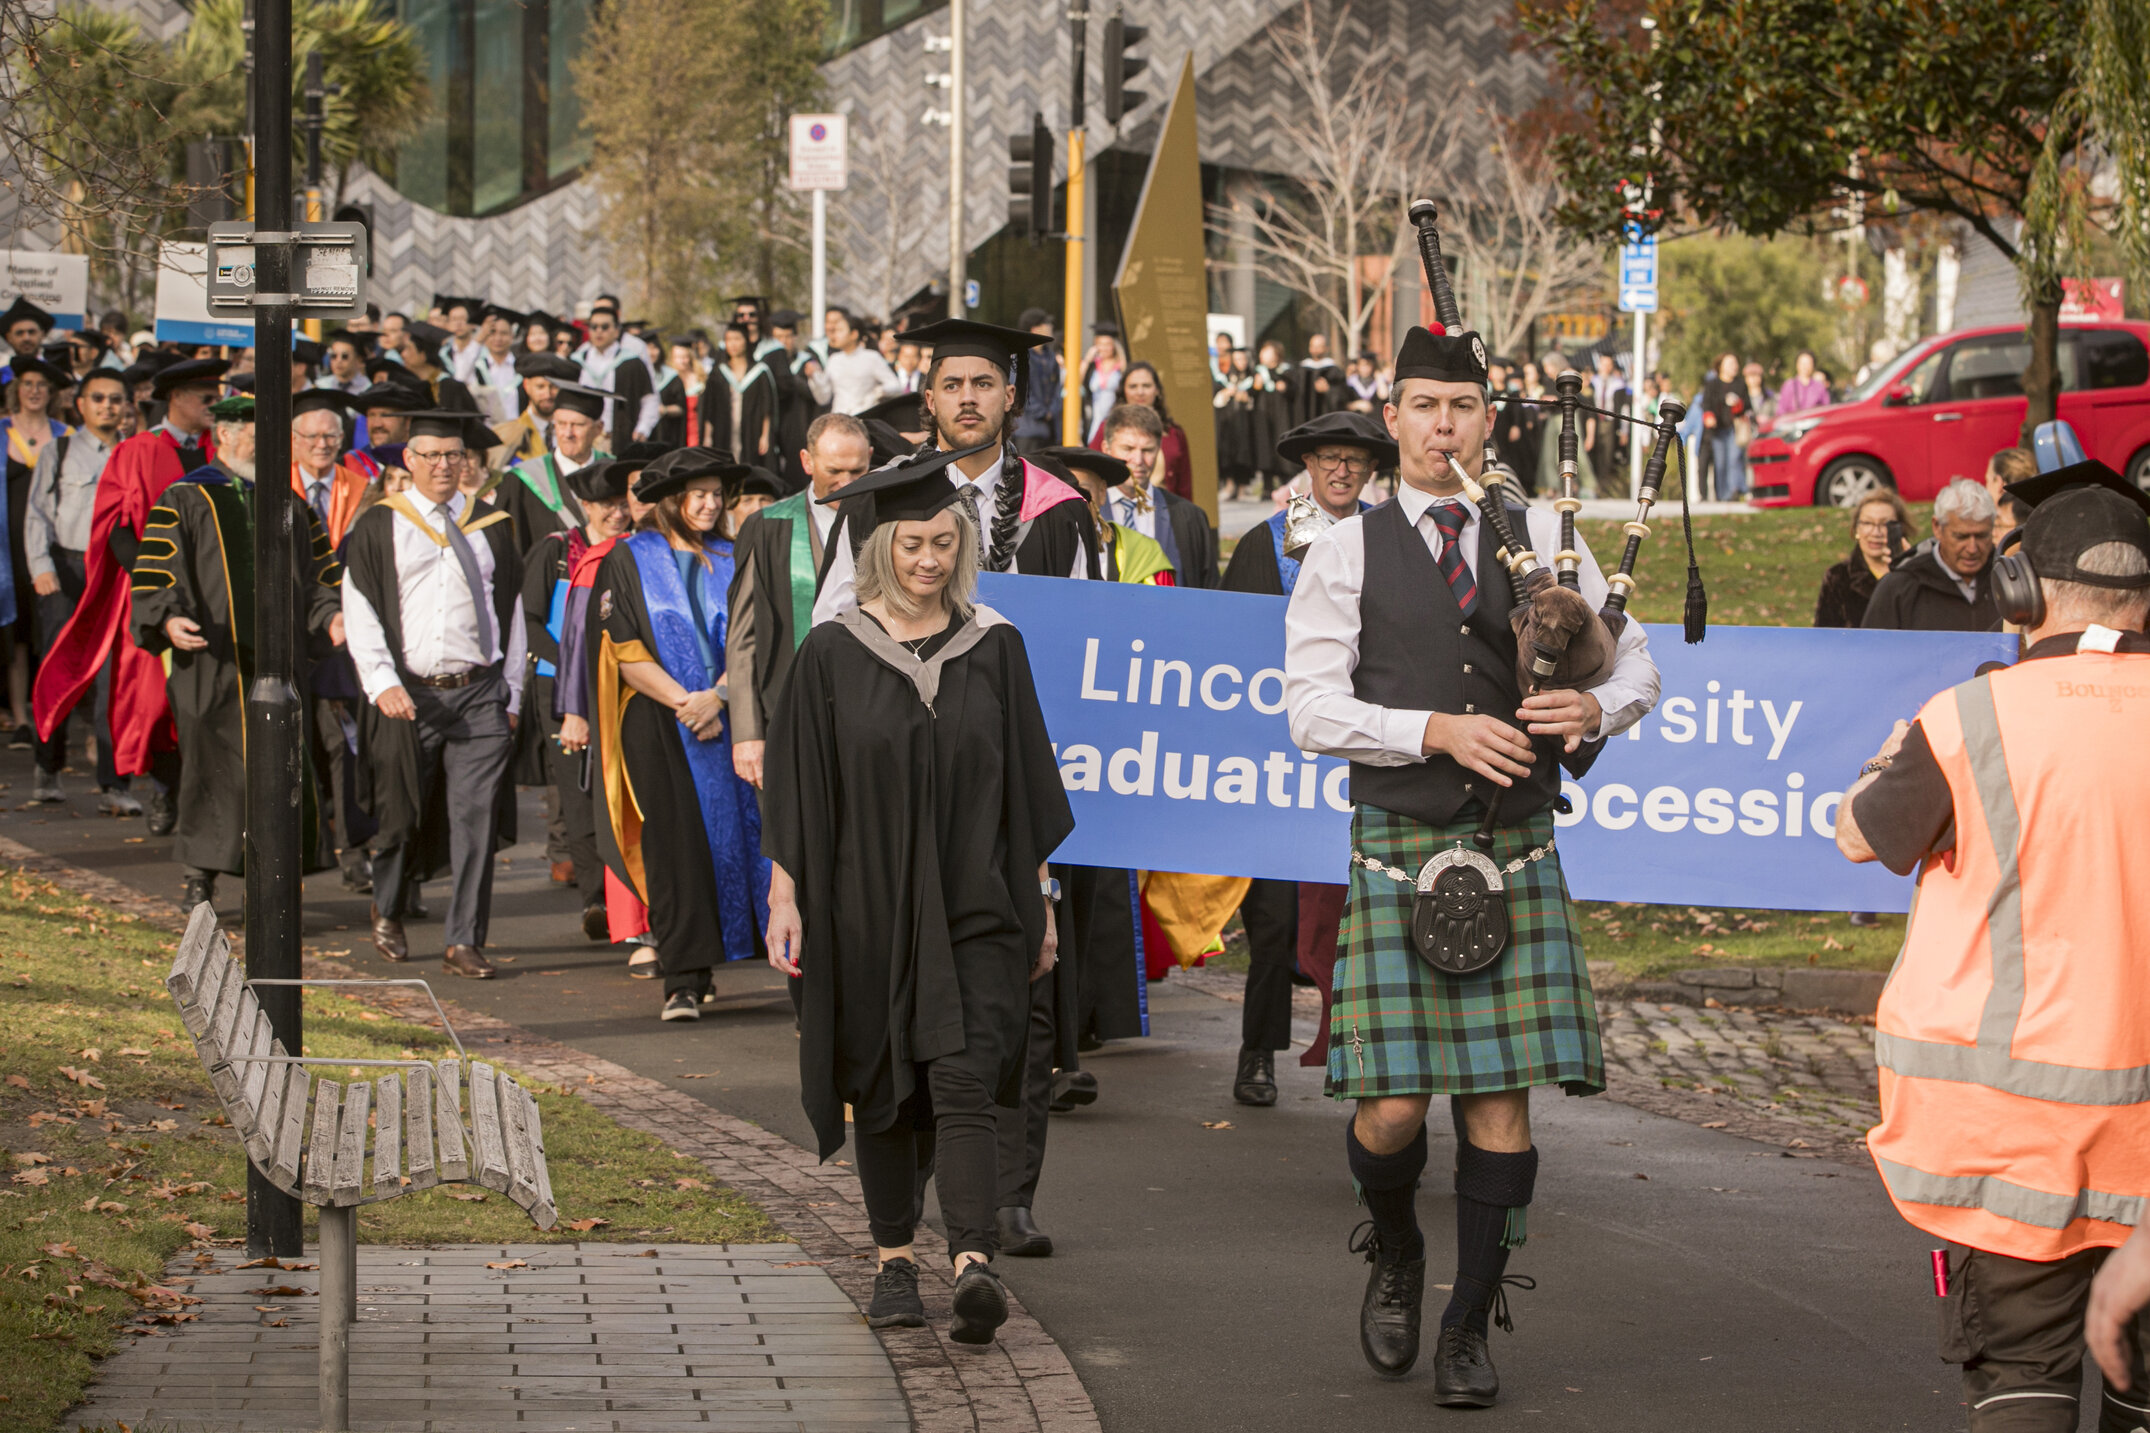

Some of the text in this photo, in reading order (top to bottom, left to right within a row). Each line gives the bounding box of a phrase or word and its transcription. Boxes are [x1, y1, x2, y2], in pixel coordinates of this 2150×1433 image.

[6, 265, 58, 276] Master of
[1052, 731, 1355, 813] aduatio
